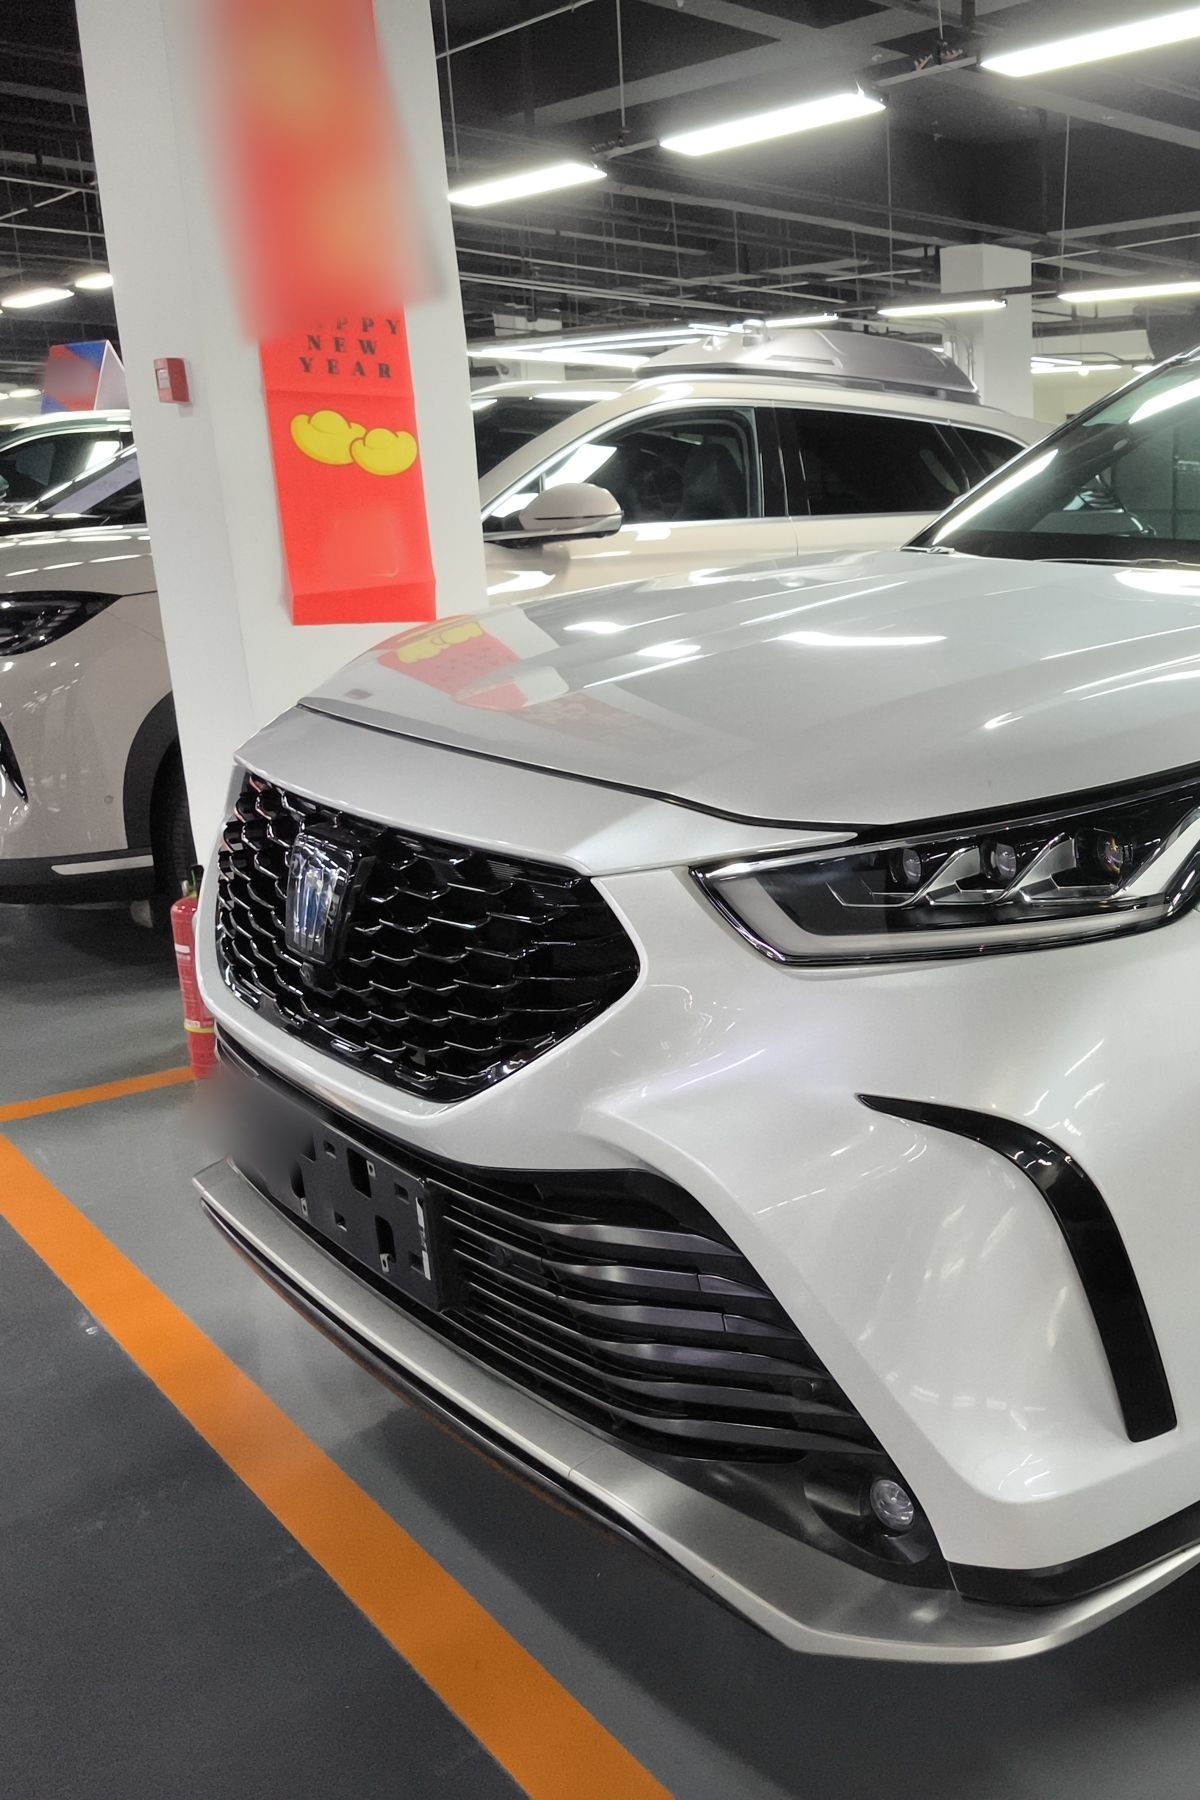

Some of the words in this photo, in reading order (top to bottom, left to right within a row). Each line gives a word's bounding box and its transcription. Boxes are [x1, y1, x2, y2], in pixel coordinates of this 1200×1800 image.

[311, 316, 401, 336] PPY
[307, 334, 377, 356] NEW
[299, 356, 392, 379] YEAR
